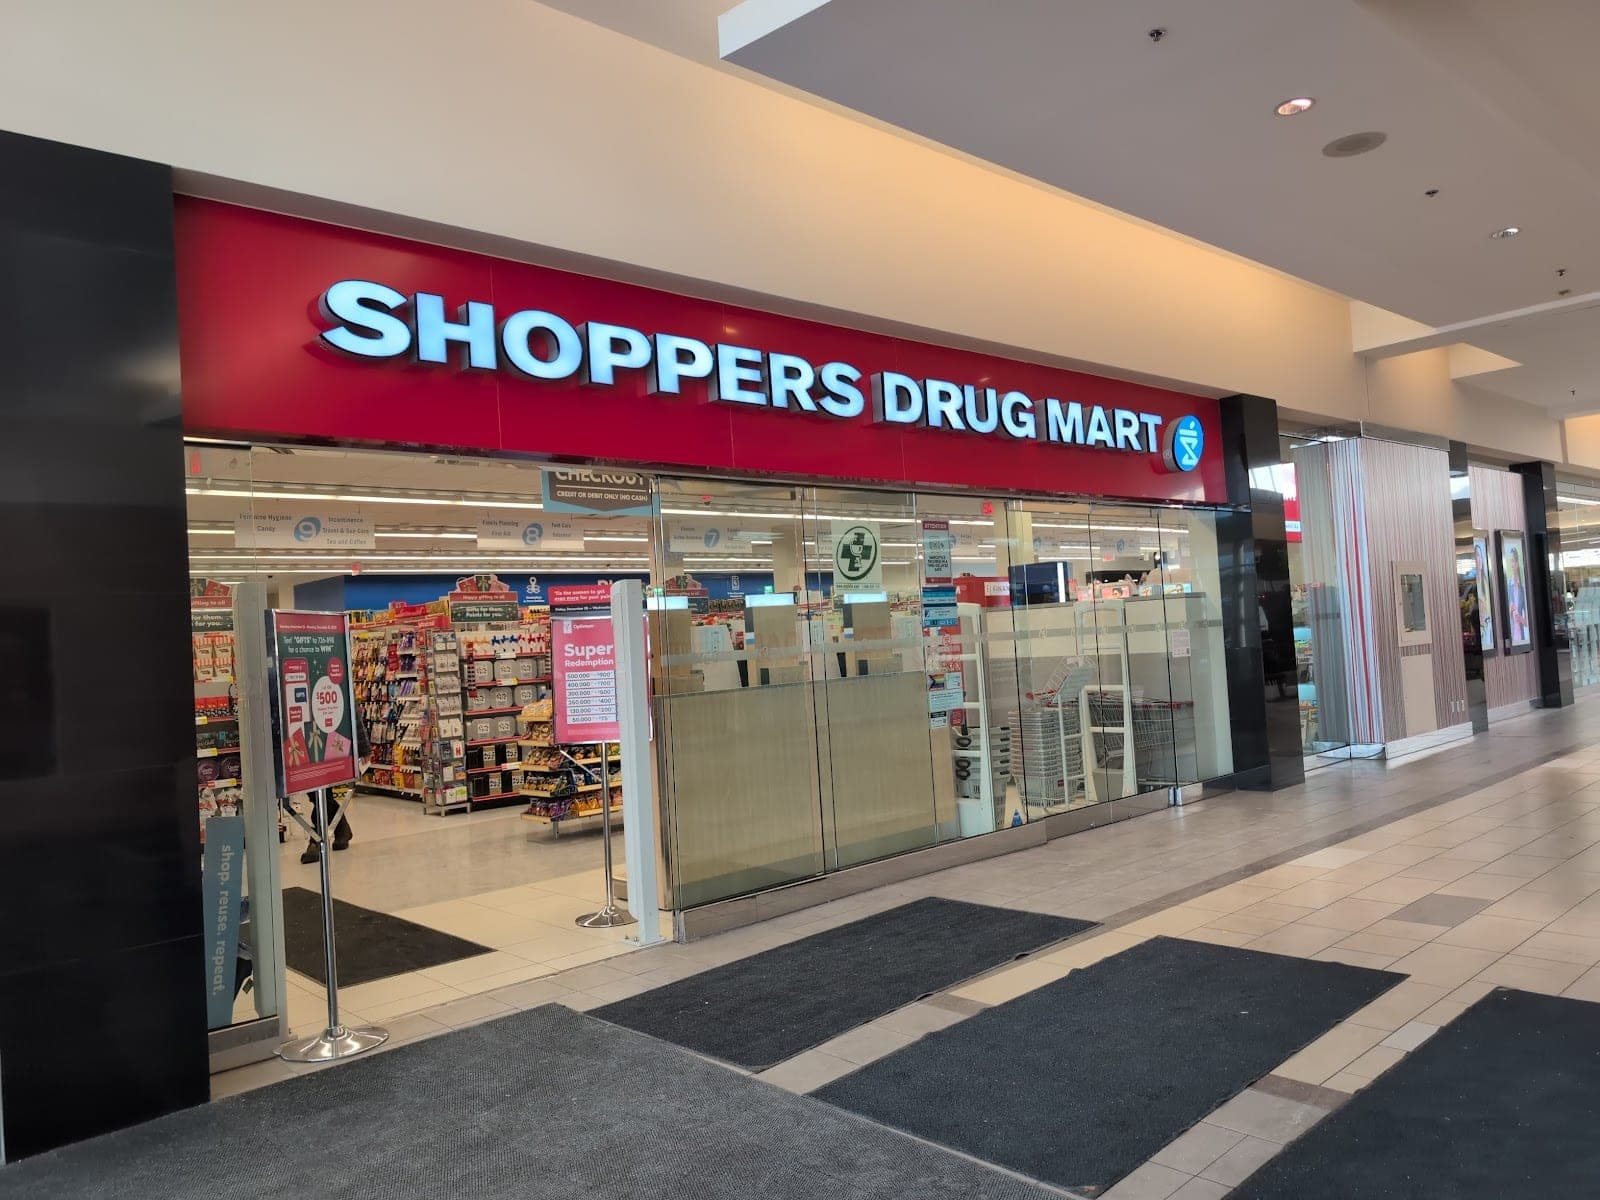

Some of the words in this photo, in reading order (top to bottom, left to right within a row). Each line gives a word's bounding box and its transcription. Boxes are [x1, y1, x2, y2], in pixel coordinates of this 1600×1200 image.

[319, 279, 865, 419] SHOPPERS
[878, 371, 1037, 440] DRUG
[1042, 398, 1163, 453] MART
[555, 471, 644, 485] CHECKOUT
[556, 490, 577, 498] CREDIT
[631, 494, 648, 502] CASH)
[268, 514, 292, 522] Hygiene
[299, 520, 318, 541] 9
[526, 527, 539, 544] 8
[564, 643, 614, 660] Super
[564, 658, 614, 668] Redemption
[316, 691, 338, 705] $500
[217, 844, 235, 886] shop.
[216, 889, 229, 936] reuse.
[211, 940, 227, 996] repeat.
